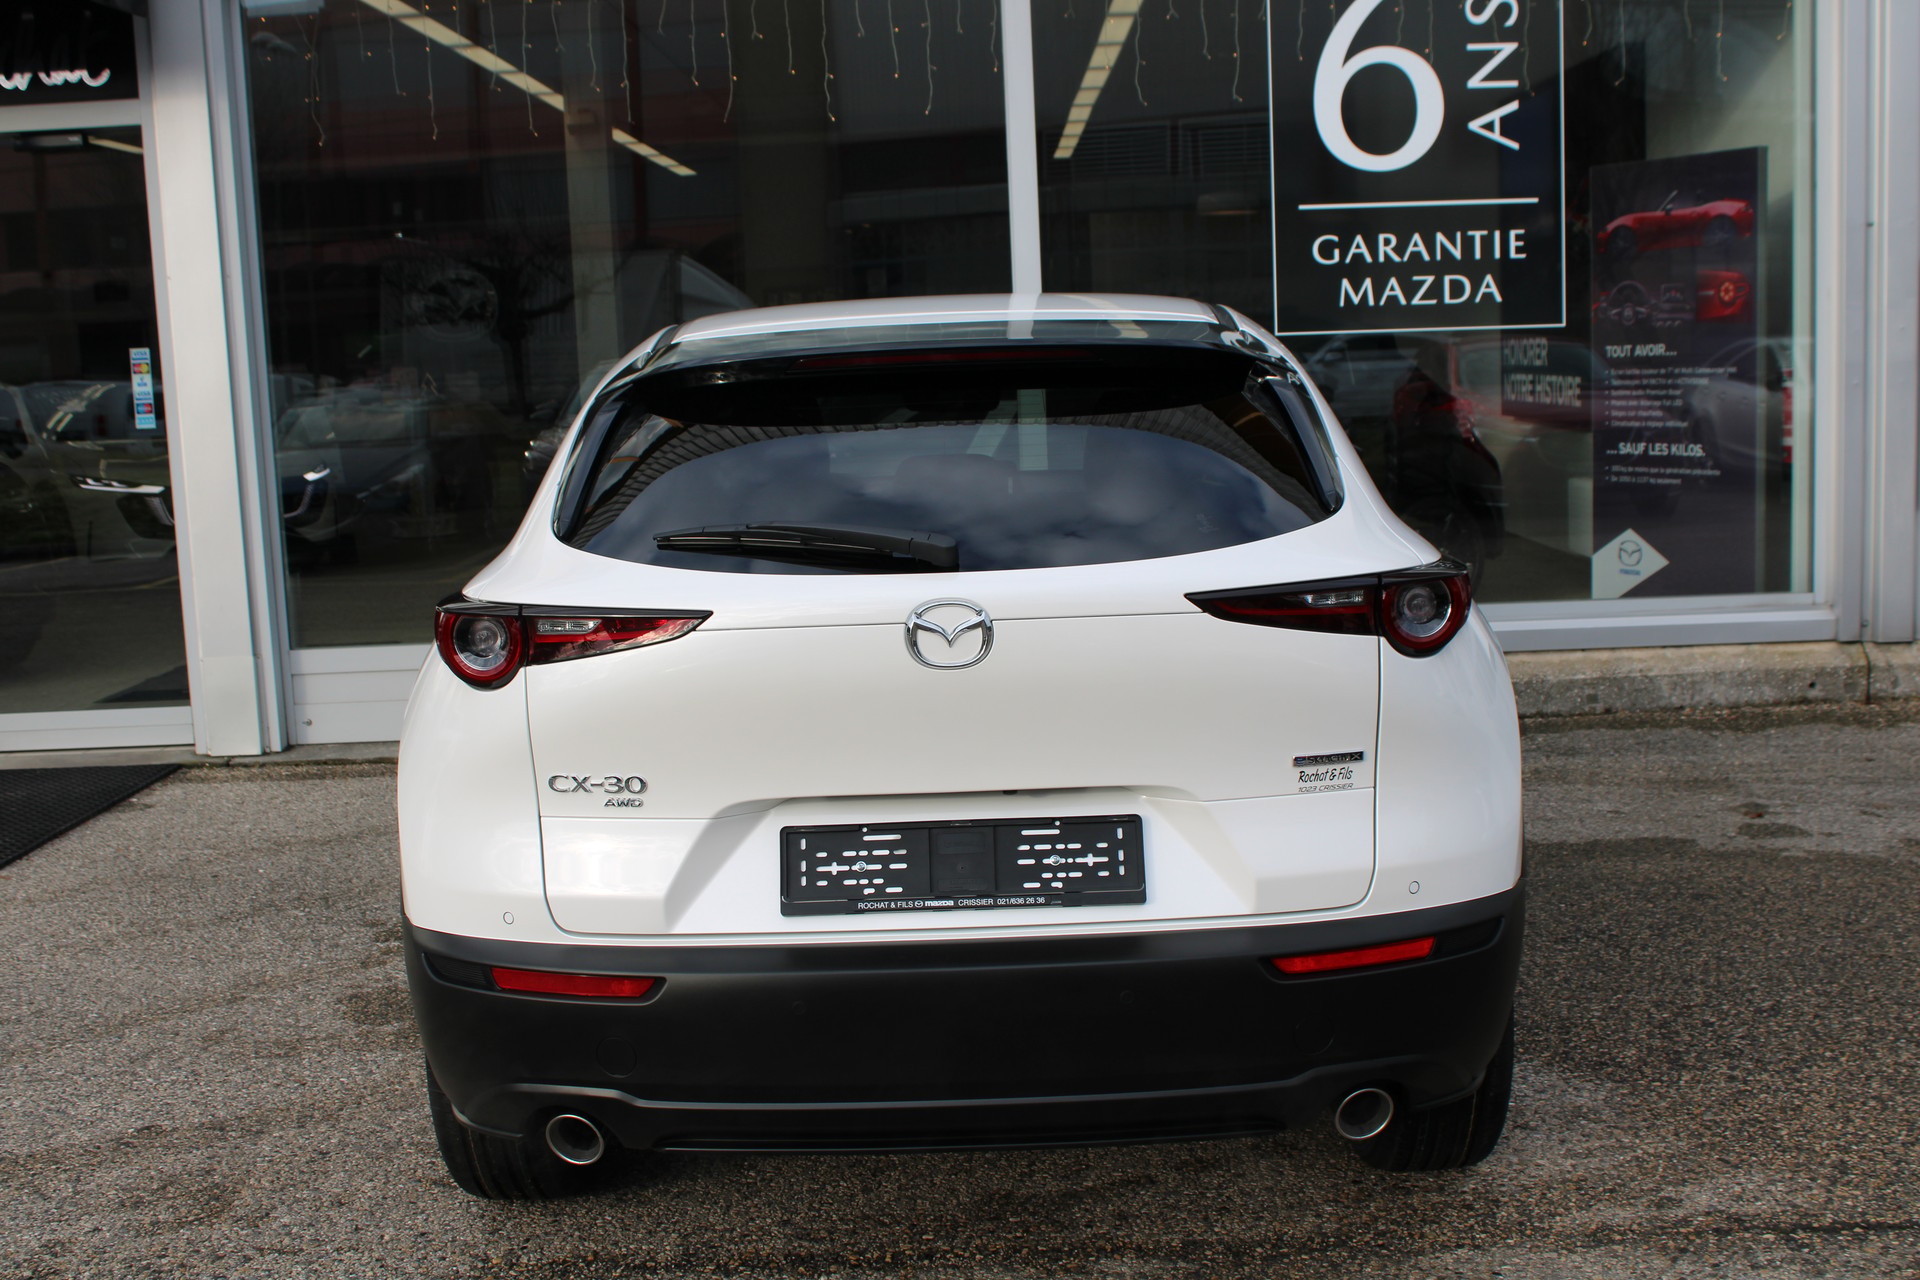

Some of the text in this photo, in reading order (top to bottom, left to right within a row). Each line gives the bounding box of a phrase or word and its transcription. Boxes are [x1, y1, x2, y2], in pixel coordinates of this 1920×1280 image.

[1464, 0, 1520, 151] ANS
[1313, 0, 1445, 172] 6
[1311, 229, 1527, 265] GARANTIE
[1339, 273, 1503, 307] MAZDA
[1503, 337, 1548, 366] HONORER
[1605, 345, 1632, 358] TOUT
[1503, 373, 1582, 407] NOTRE HISTOIRE
[1648, 442, 1669, 456] LES
[1297, 766, 1353, 783] Rochat & Fils
[548, 775, 648, 794] CX-30
[1318, 782, 1354, 792] CRISSIER
[604, 797, 644, 808] AWD
[958, 898, 994, 906] CRISSIER
[996, 897, 1025, 905] 021/636
[1036, 896, 1046, 904] 36
